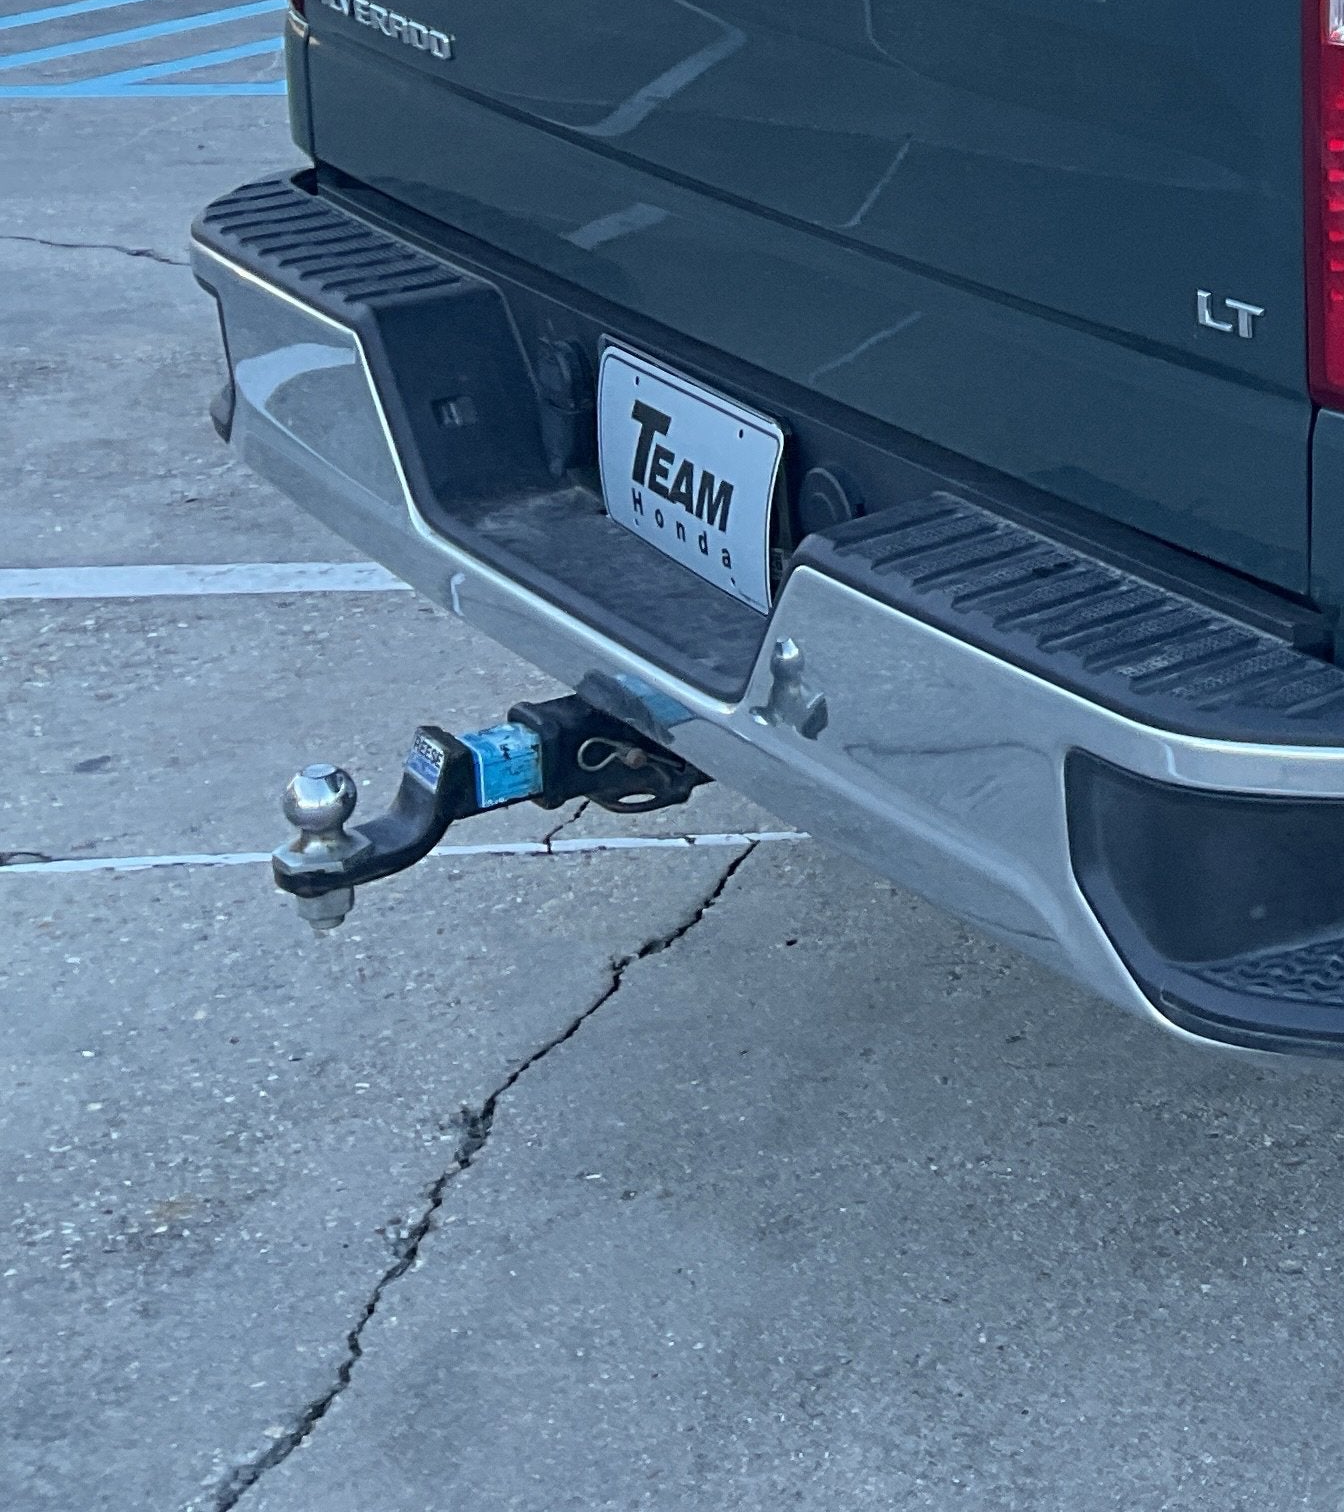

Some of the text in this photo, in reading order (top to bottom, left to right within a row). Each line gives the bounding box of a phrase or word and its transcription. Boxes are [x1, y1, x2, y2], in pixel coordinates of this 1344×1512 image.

[1197, 289, 1265, 339] LT
[630, 399, 735, 533] TEAM
[630, 487, 732, 569] Honda
[414, 737, 445, 769] REESE
